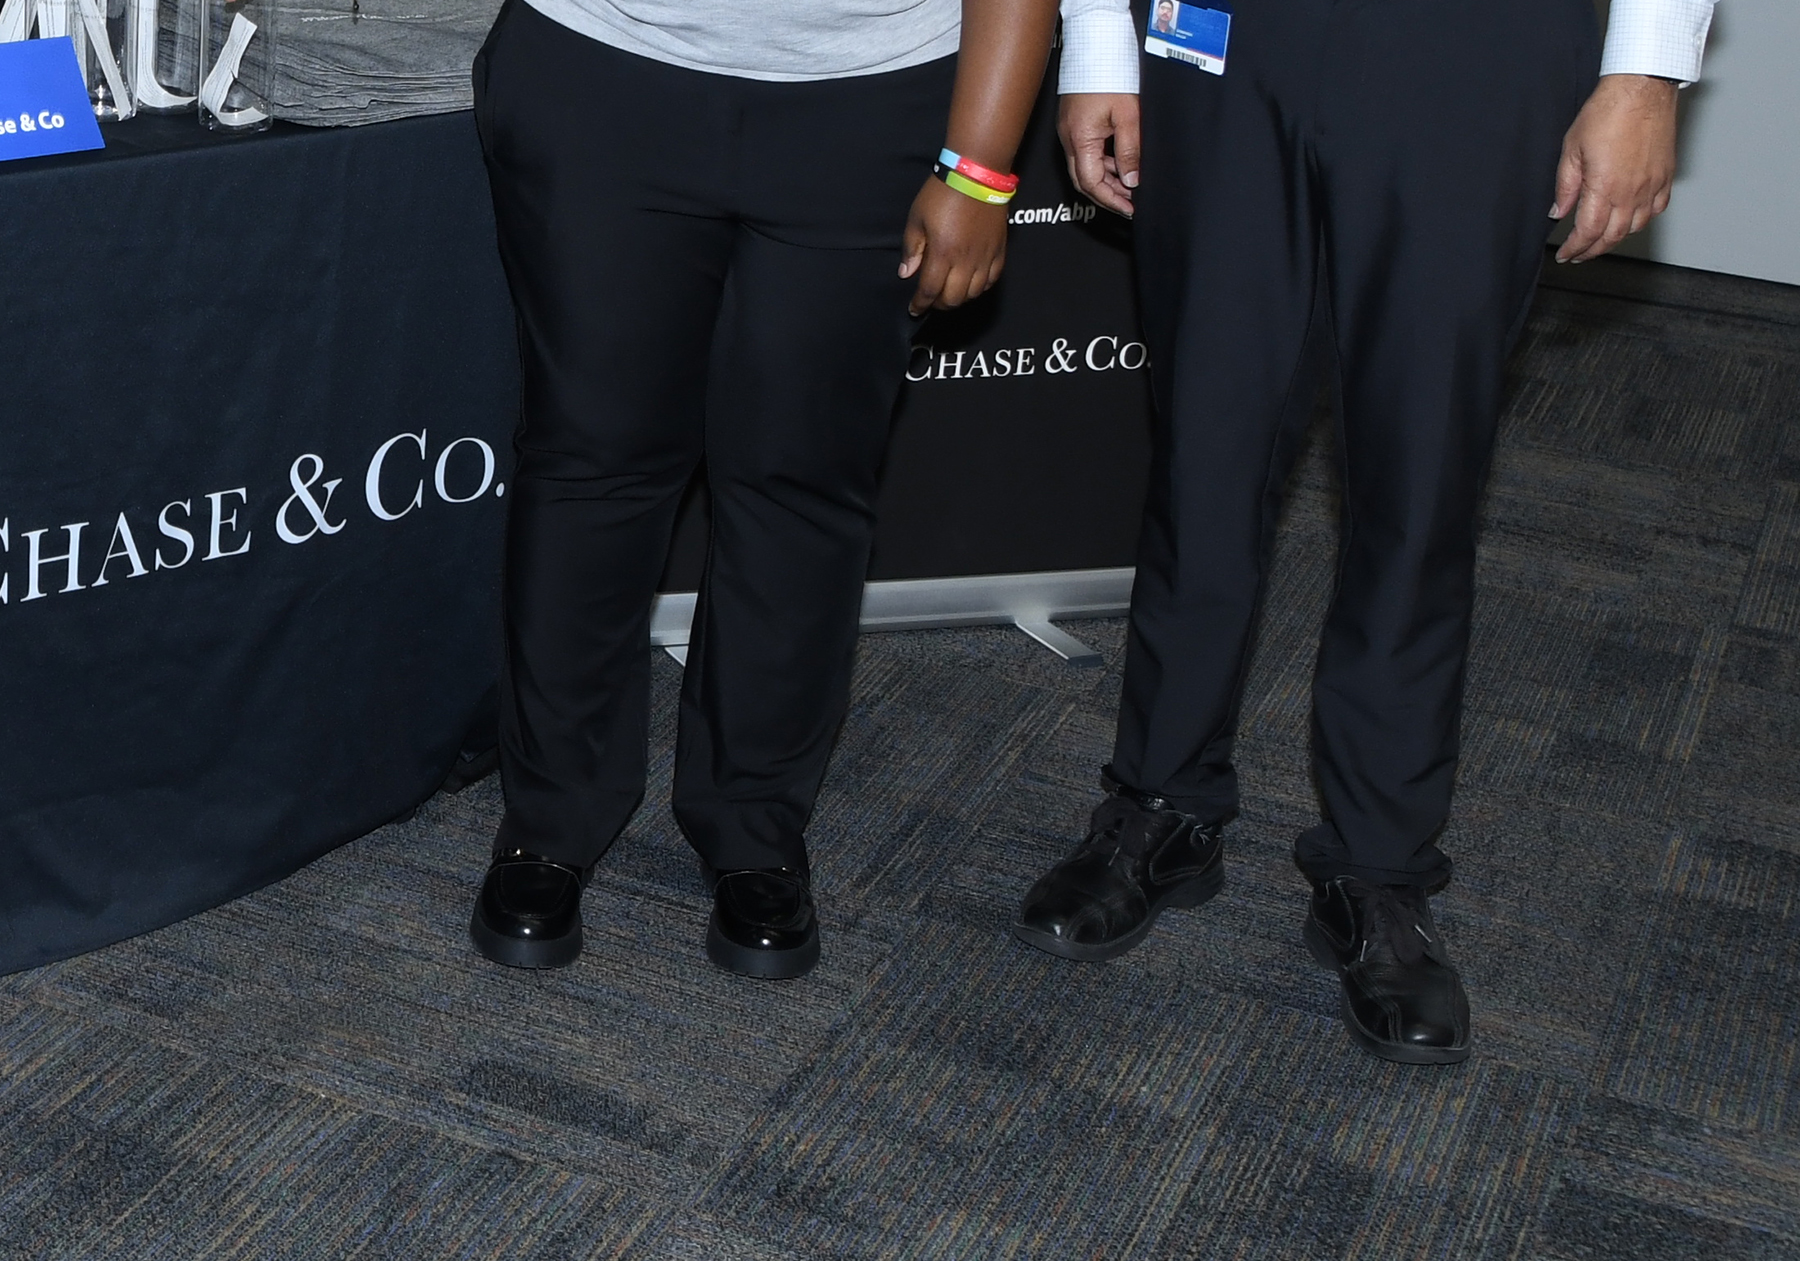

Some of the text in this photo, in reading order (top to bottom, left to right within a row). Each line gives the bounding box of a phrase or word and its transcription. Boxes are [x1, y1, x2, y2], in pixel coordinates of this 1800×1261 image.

[20, 113, 37, 132] &
[39, 110, 65, 130] Co
[1008, 202, 1096, 224] .com/abp
[905, 344, 1036, 381] CHASE
[1045, 337, 1078, 374] &
[275, 451, 347, 544] &
[365, 431, 507, 523] CO.
